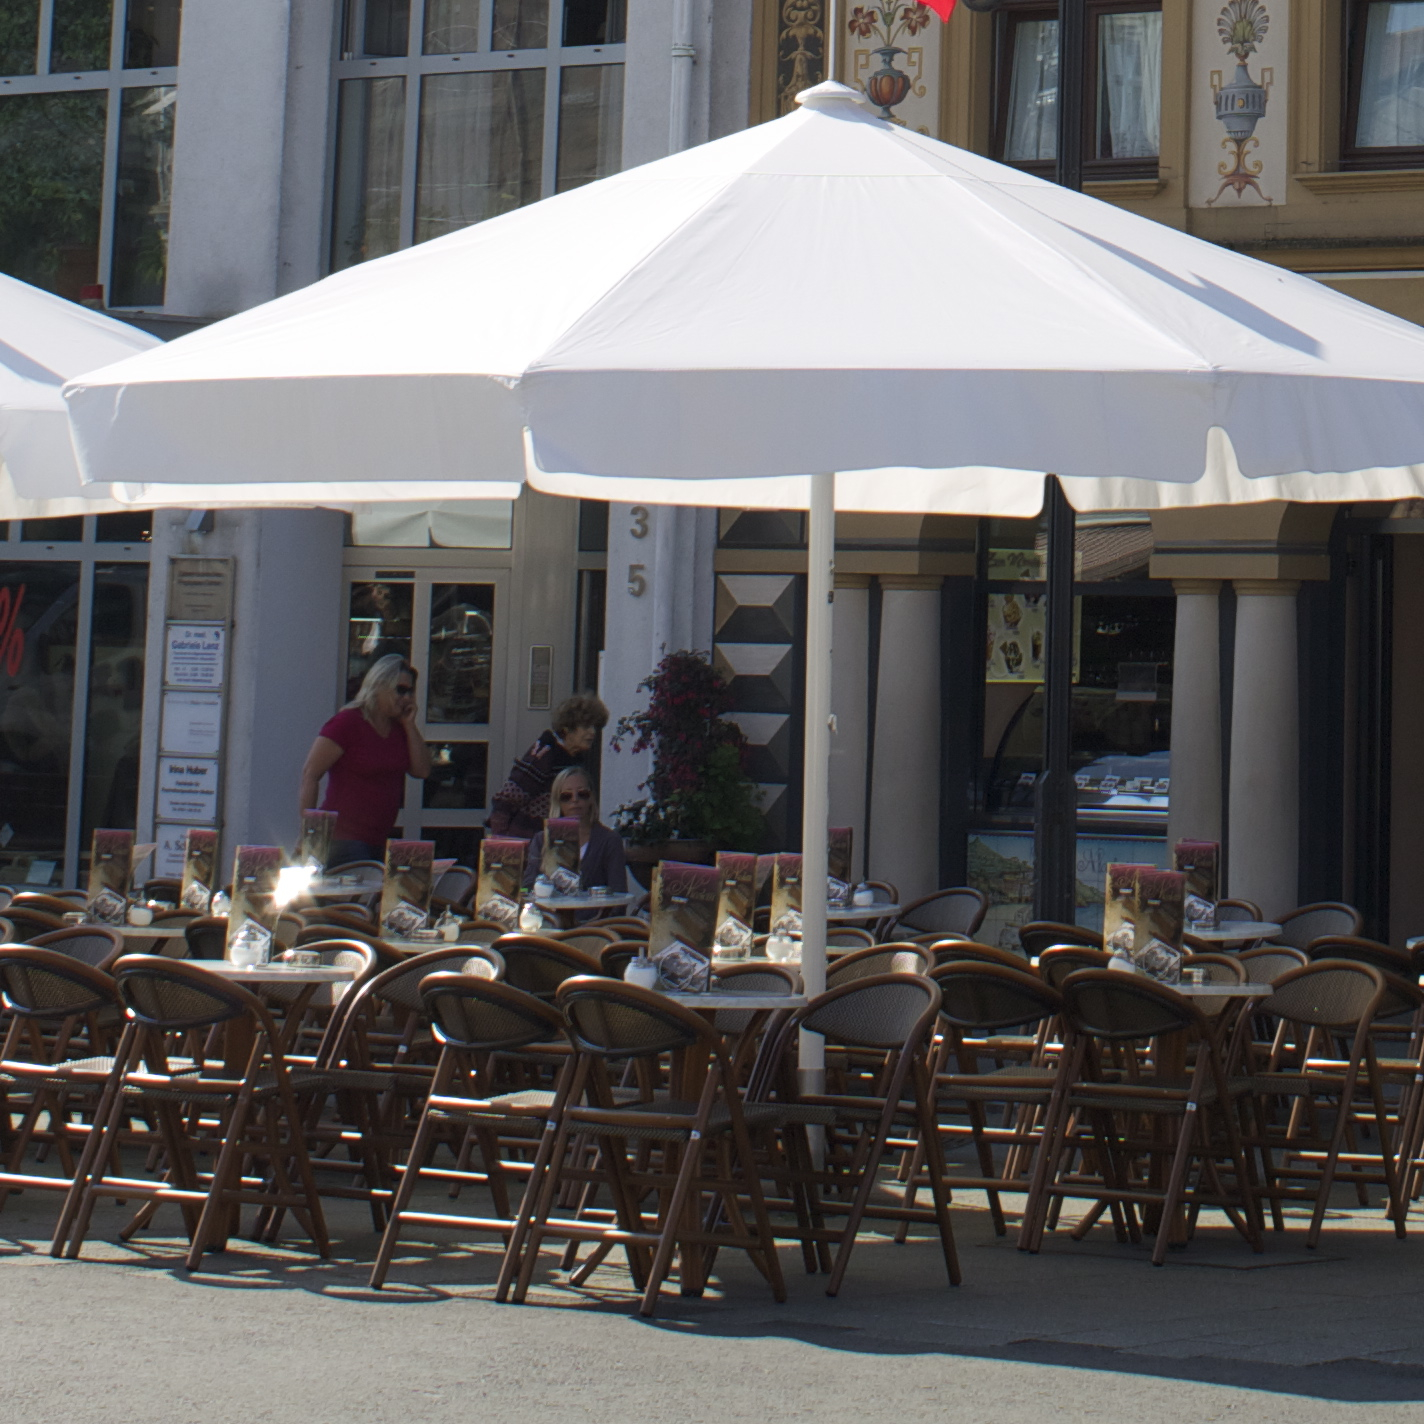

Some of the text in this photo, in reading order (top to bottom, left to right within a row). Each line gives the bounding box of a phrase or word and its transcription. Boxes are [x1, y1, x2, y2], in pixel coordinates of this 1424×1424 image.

[630, 505, 649, 539] 3
[628, 564, 647, 597] 5
[186, 764, 208, 775] Huber
